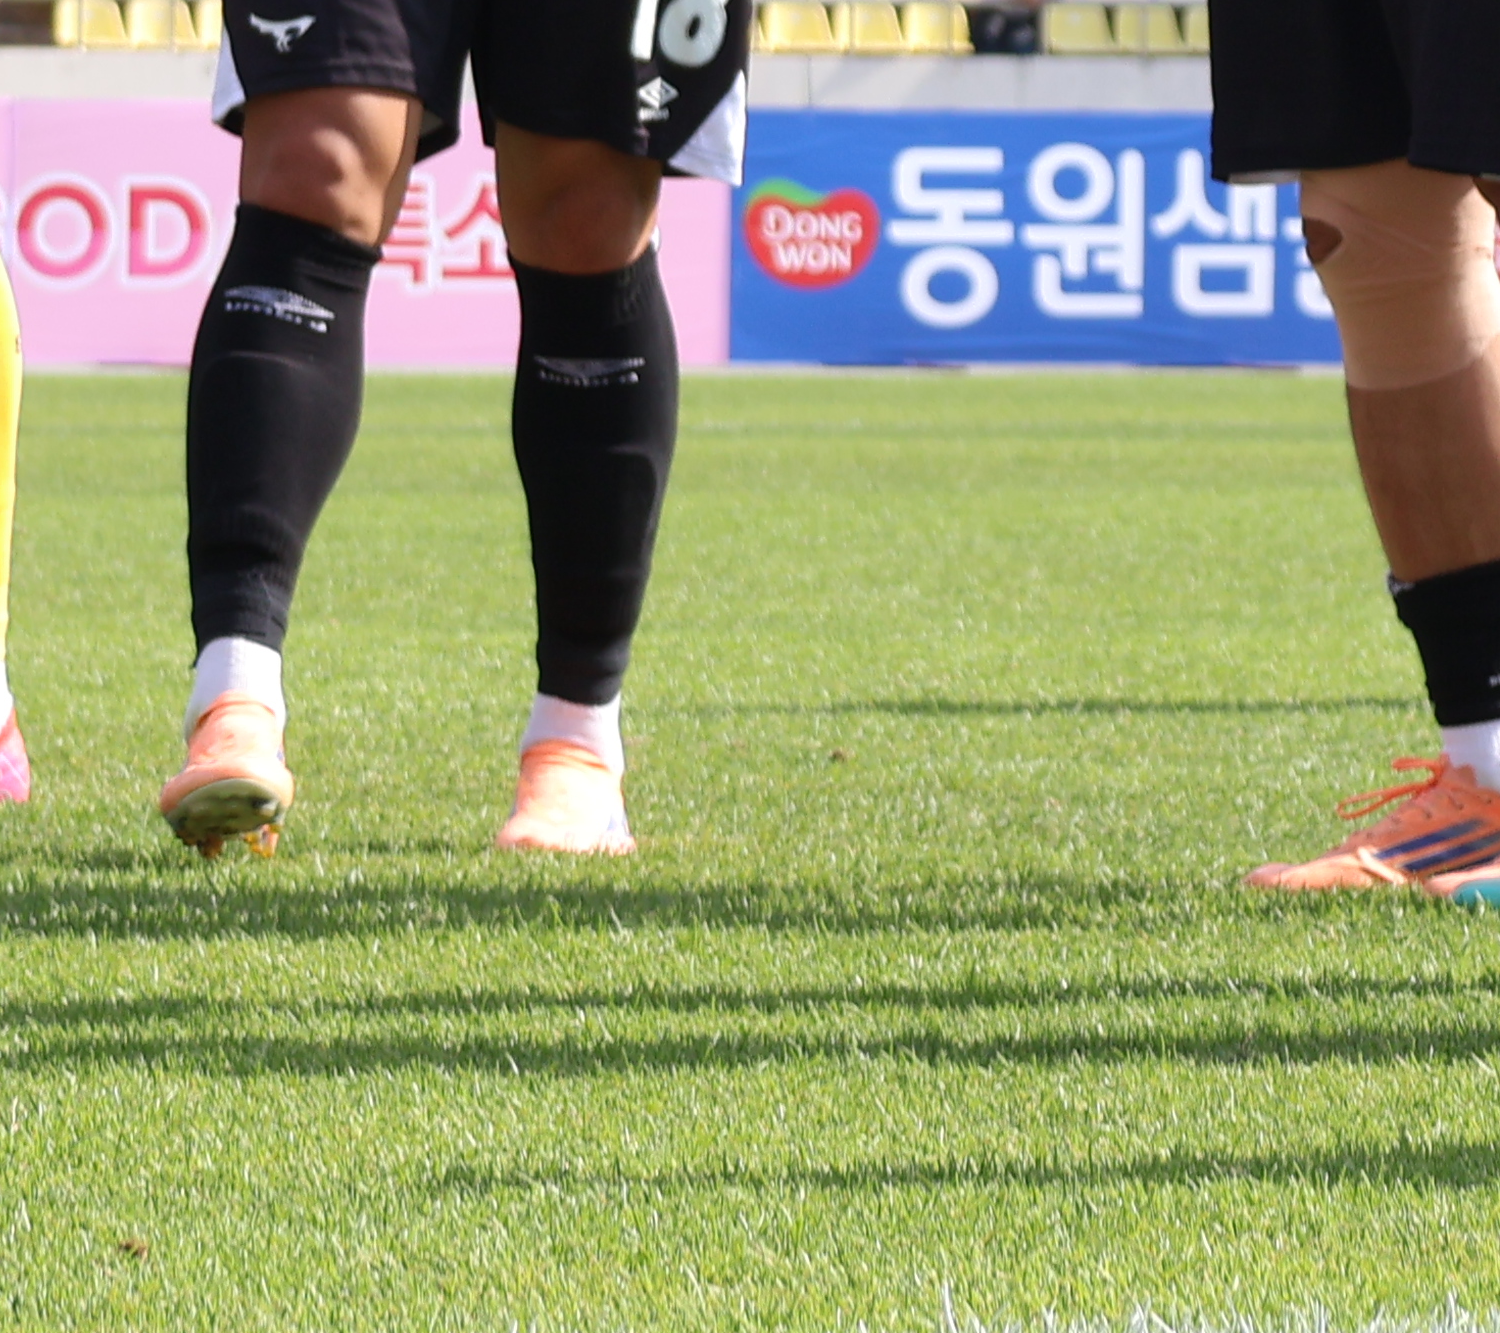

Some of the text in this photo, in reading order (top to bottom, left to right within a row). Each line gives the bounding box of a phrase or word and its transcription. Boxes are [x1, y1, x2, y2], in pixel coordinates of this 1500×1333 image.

[761, 205, 863, 244] DONG
[886, 141, 1345, 328] 동원샘
[773, 242, 853, 275] WON
